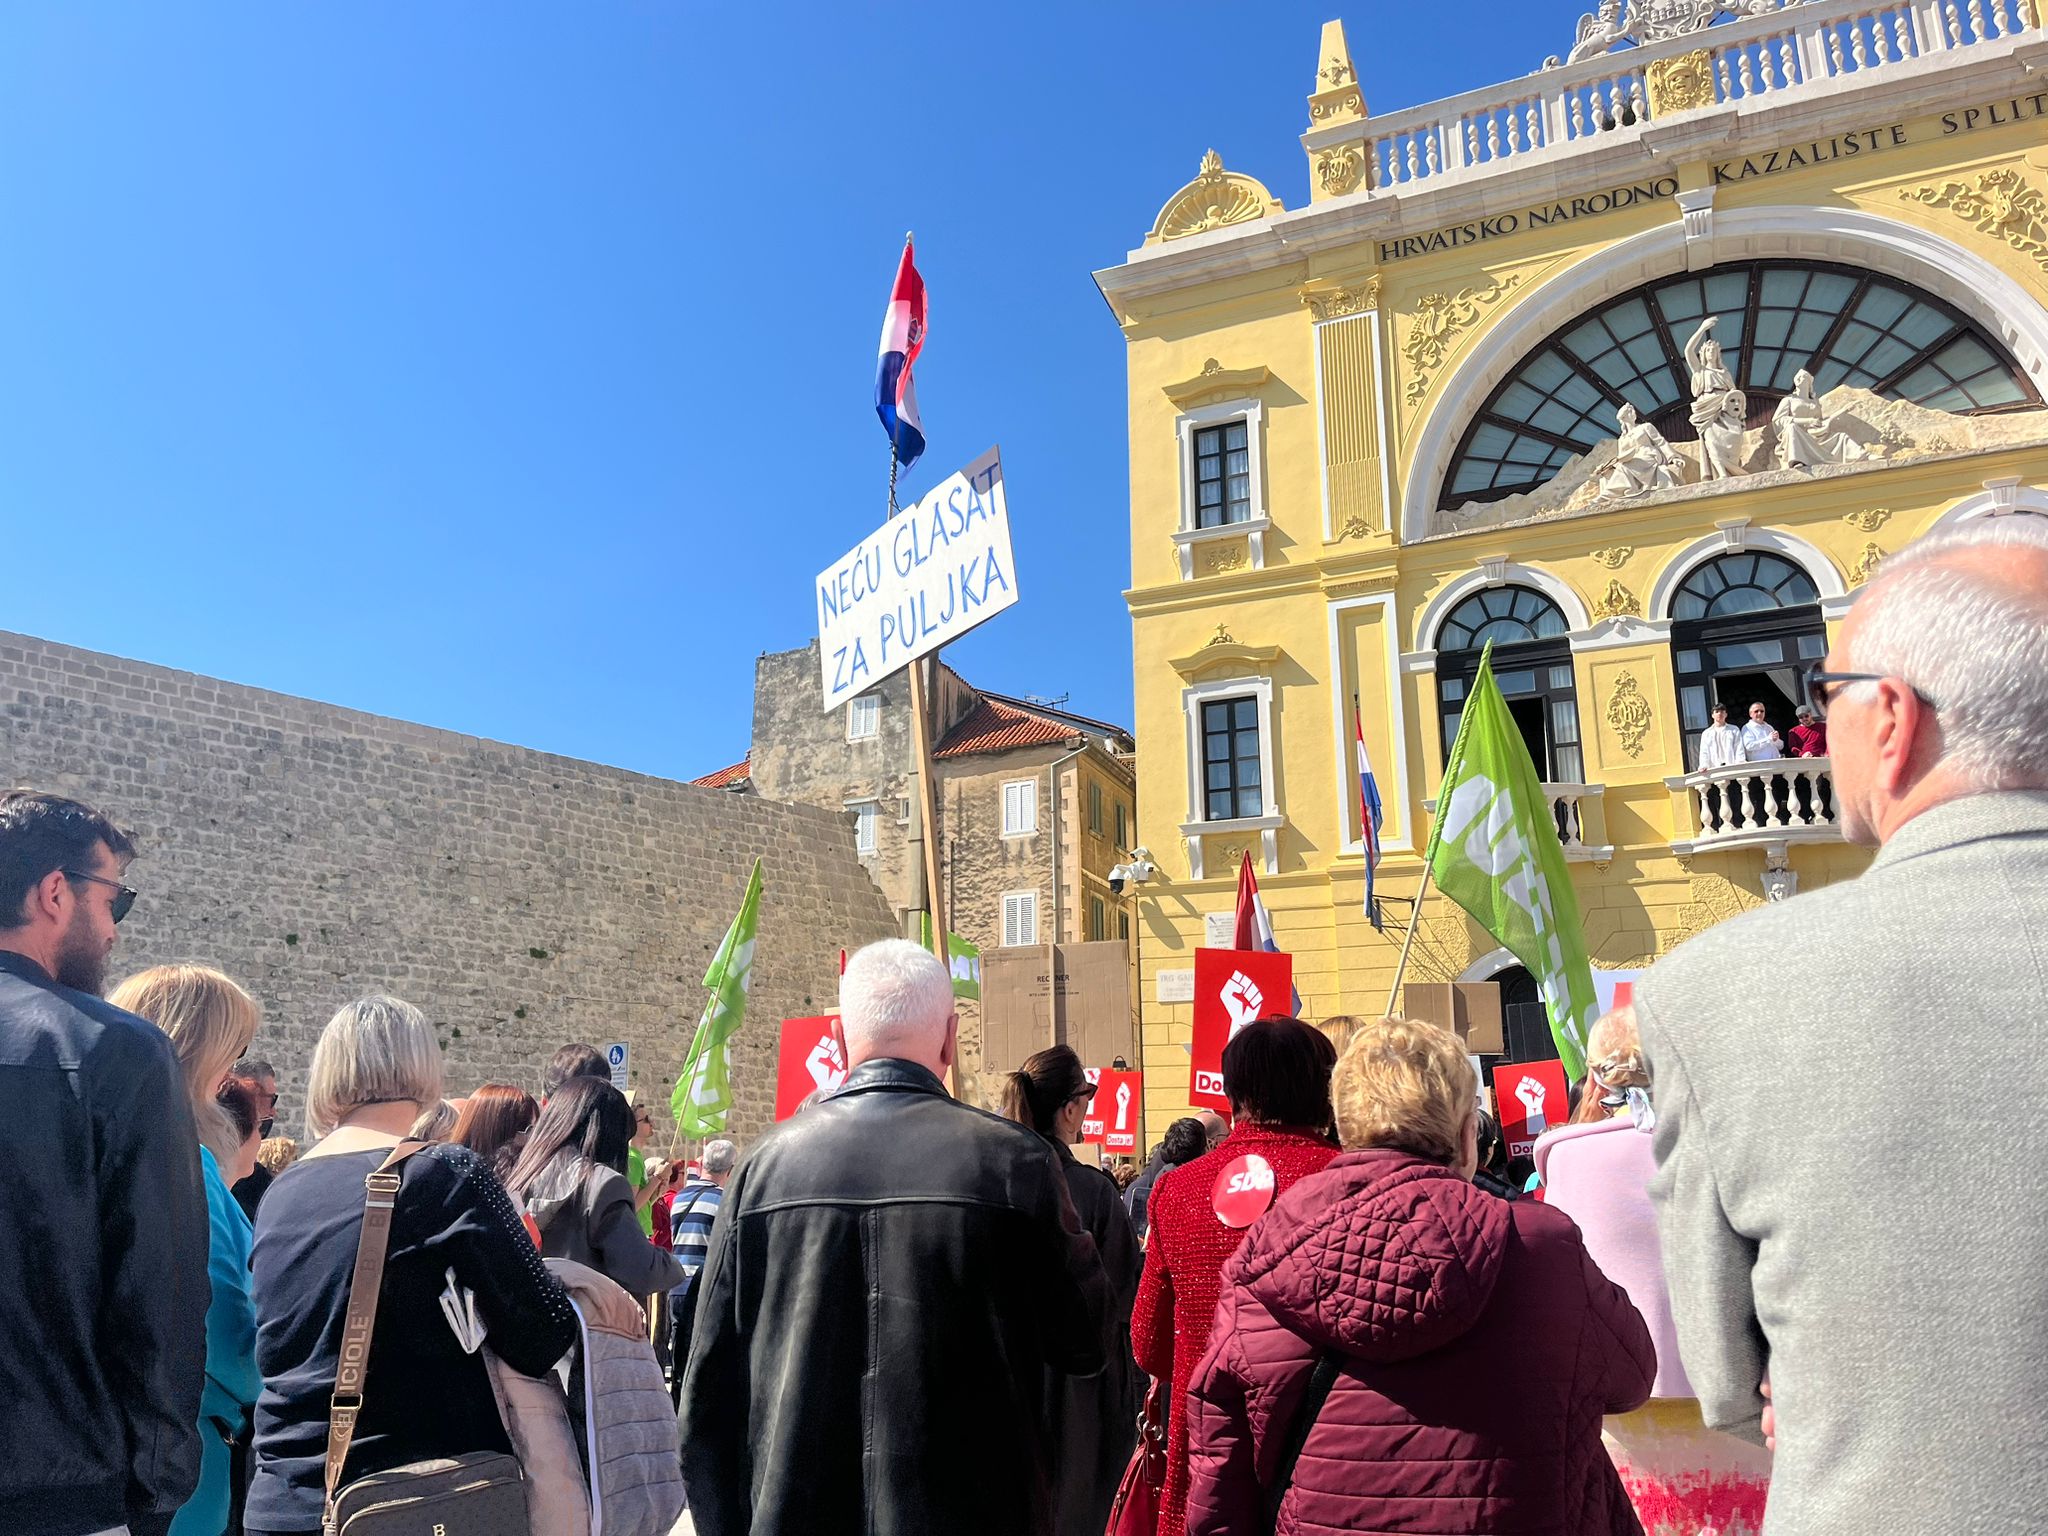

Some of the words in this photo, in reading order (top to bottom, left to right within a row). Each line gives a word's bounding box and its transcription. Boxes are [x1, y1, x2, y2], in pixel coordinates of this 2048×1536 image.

[1380, 214, 1518, 262] HRVATSKO
[1528, 178, 1678, 228] NARODNO
[1713, 124, 1907, 184] KAZALIŠTE
[1942, 93, 2048, 134] SPLIT
[821, 545, 881, 629] NEĆU
[893, 462, 998, 578] GLASAT
[832, 636, 869, 694] ZA
[880, 546, 1009, 665] PULJKA
[1036, 974, 1070, 983] RECNER
[1198, 1074, 1224, 1092] Do
[338, 1315, 369, 1391] ICIOLE
